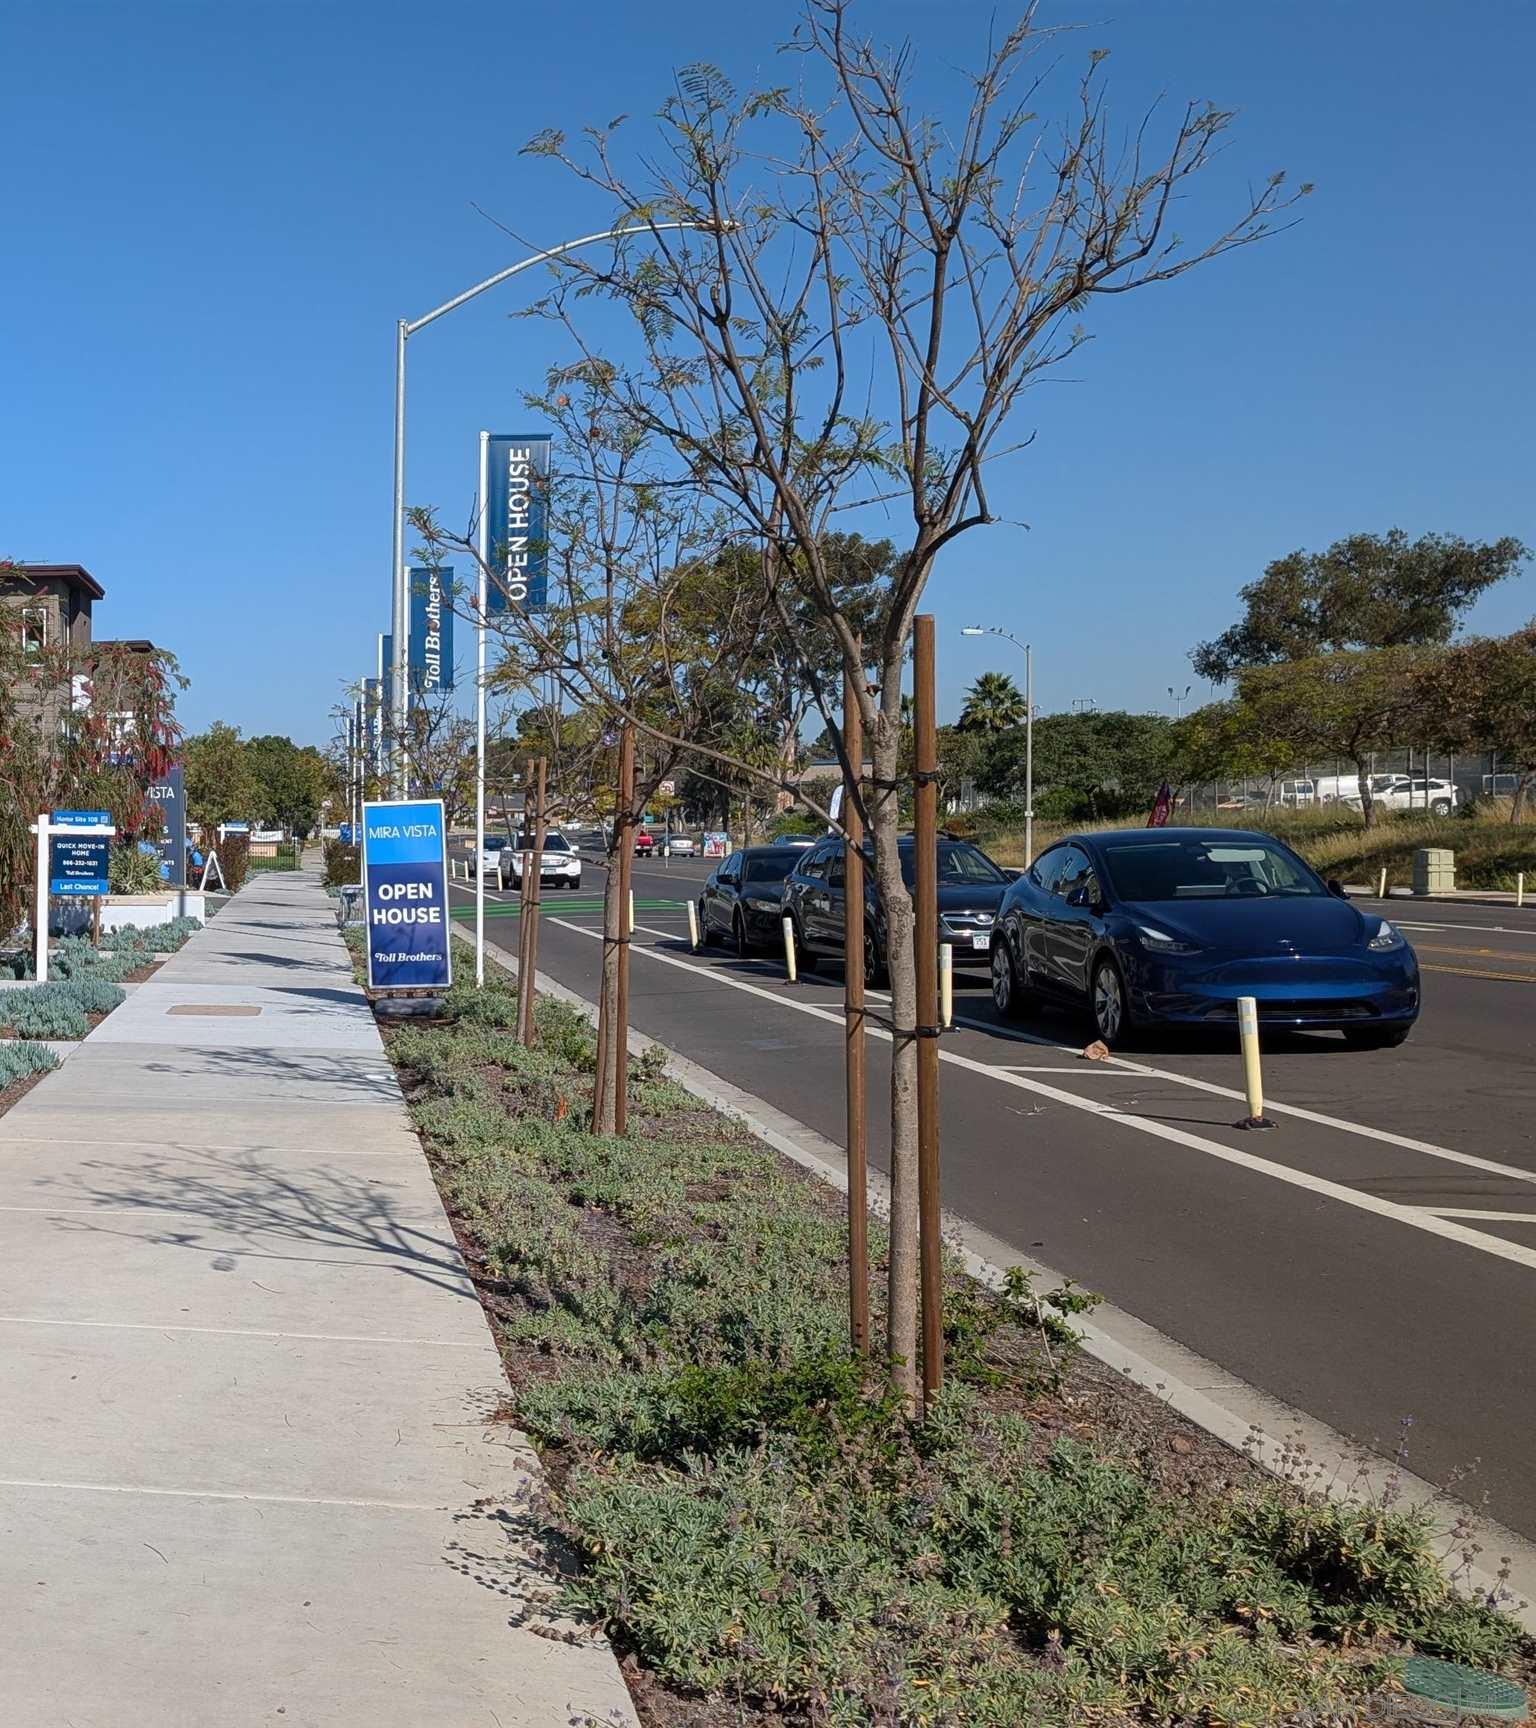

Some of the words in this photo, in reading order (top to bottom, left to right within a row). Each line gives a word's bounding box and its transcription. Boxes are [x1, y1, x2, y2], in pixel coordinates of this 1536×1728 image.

[508, 447, 530, 529] HOUSE
[507, 536, 529, 601] OPEN
[424, 653, 441, 688] Toll
[368, 826, 401, 839] MIRA
[402, 824, 438, 838] VISTA
[378, 882, 433, 900] OPEN
[372, 906, 441, 925] HOUSE
[374, 952, 396, 963] Toll
[396, 951, 443, 963] Brothers
